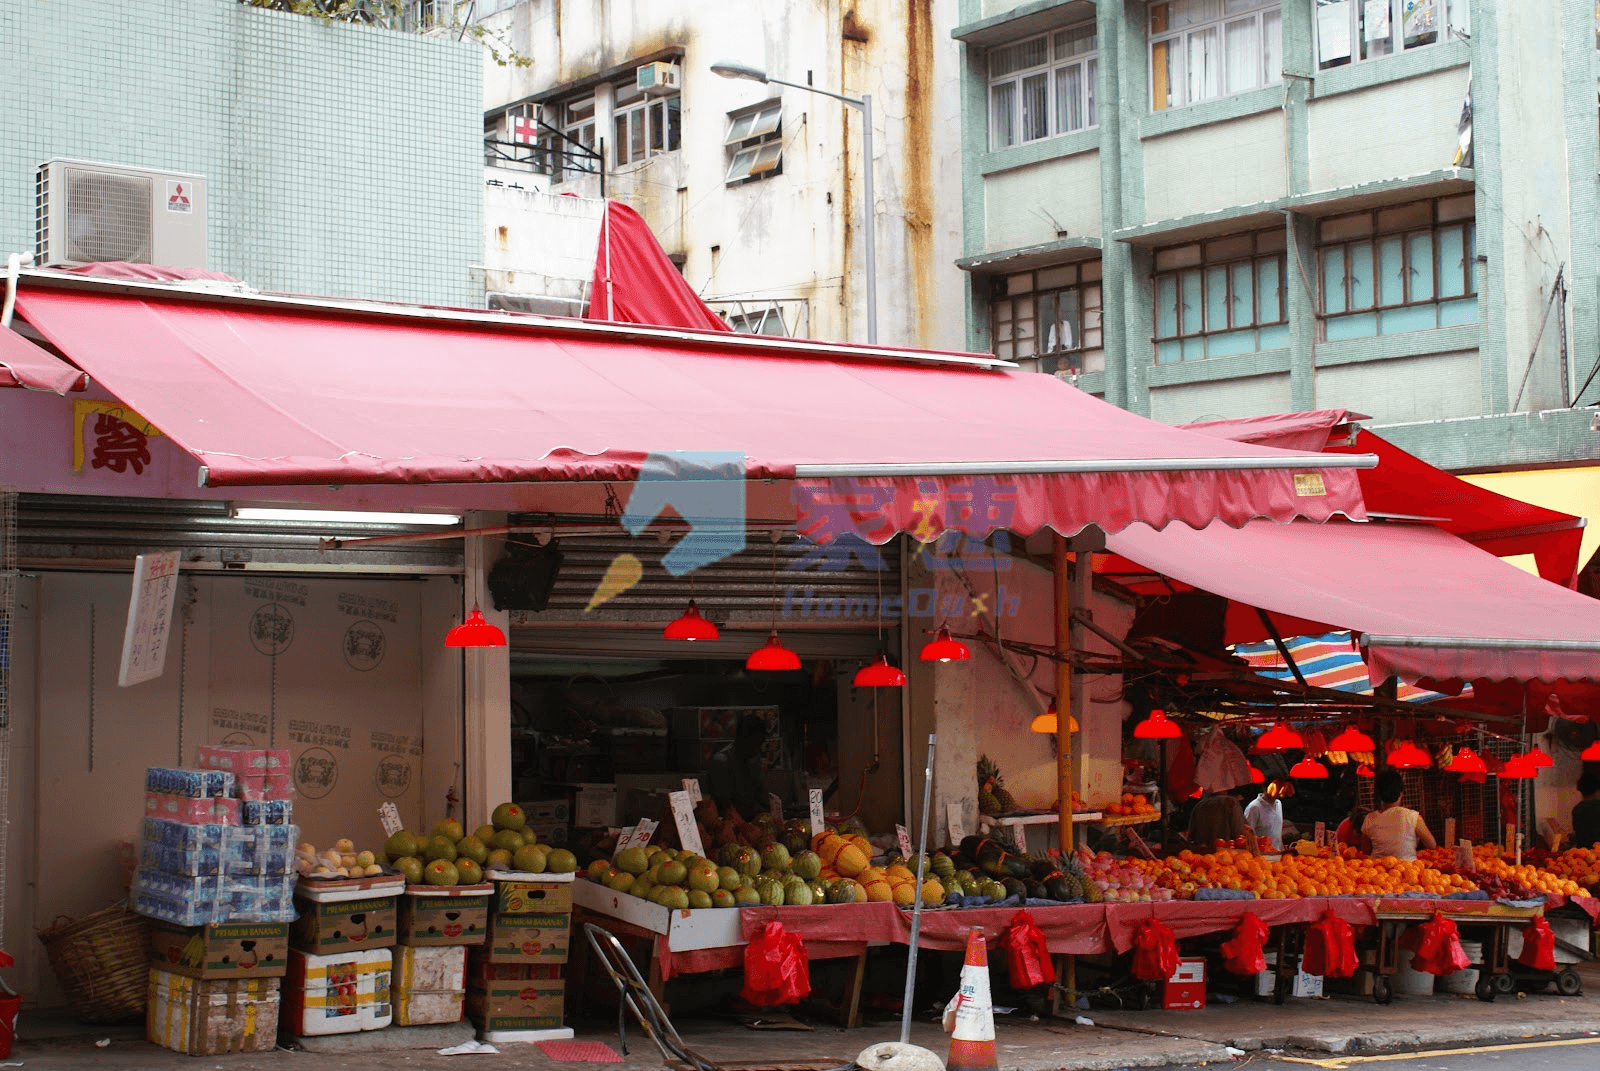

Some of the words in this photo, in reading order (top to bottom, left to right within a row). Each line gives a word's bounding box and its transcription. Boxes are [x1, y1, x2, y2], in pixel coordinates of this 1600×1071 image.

[318, 723, 339, 736] QUALITY
[810, 790, 822, 803] 20
[635, 832, 650, 842] 20
[501, 917, 533, 927] PREMIUM
[533, 918, 564, 927] BANANAS
[215, 929, 248, 938] PREMIUM
[249, 927, 282, 936] BANANAS
